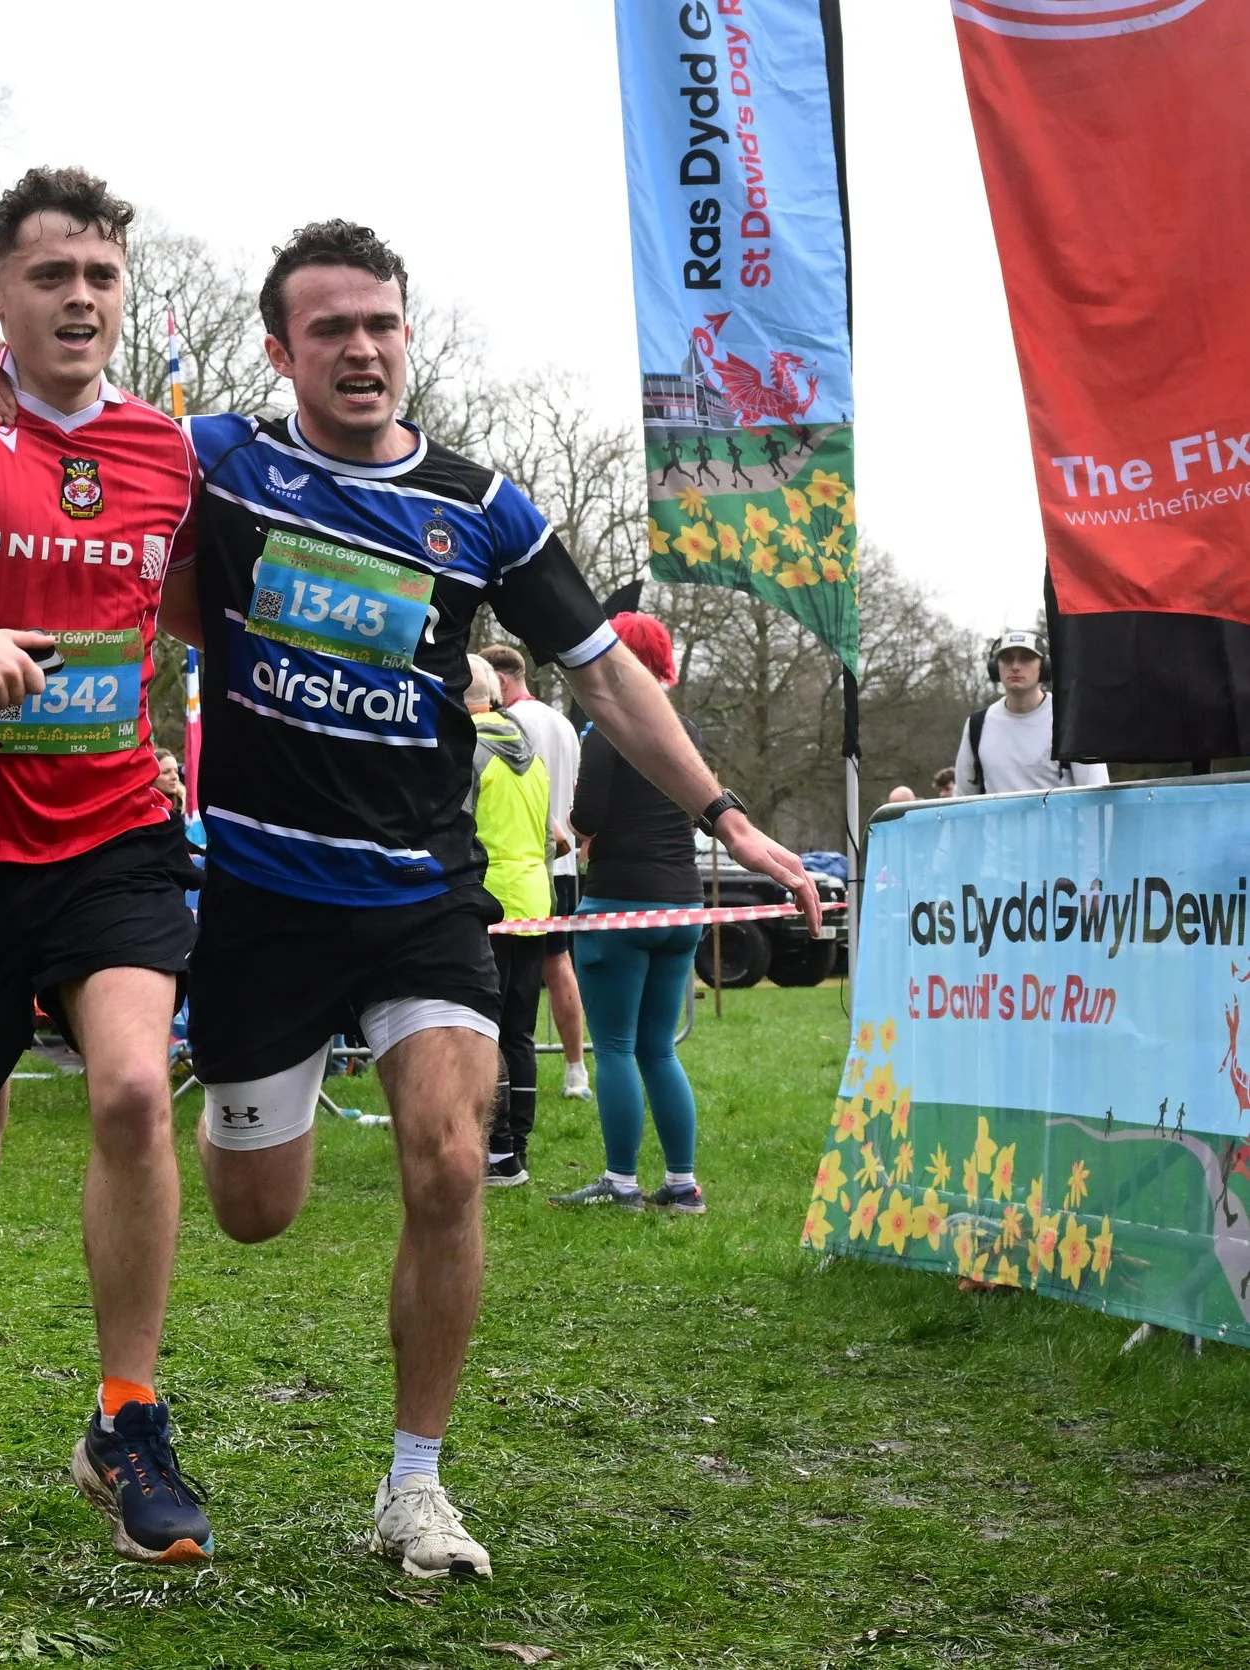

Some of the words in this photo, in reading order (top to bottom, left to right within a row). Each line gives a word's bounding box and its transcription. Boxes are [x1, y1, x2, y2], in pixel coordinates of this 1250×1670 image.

[724, 24, 751, 97] Day
[679, 53, 730, 186] Dydd
[737, 106, 772, 239] David's
[683, 198, 721, 290] Ras
[740, 247, 771, 288] St
[1051, 455, 1152, 497] The
[1170, 430, 1250, 482] Fix
[265, 484, 302, 501] CASTORE
[272, 531, 297, 546] Ras
[298, 537, 334, 555] Dydd
[369, 557, 401, 577] Dewi
[318, 558, 339, 571] Day
[289, 579, 388, 637] 1343
[96, 631, 125, 644] Dewi
[381, 653, 405, 669] HM
[252, 658, 421, 724] airstrait
[70, 745, 87, 753] 1342
[118, 722, 134, 737] HM
[908, 889, 956, 946] as
[962, 879, 1047, 957] Dydd
[1143, 876, 1247, 946] Dewi
[1061, 974, 1117, 1025] Run
